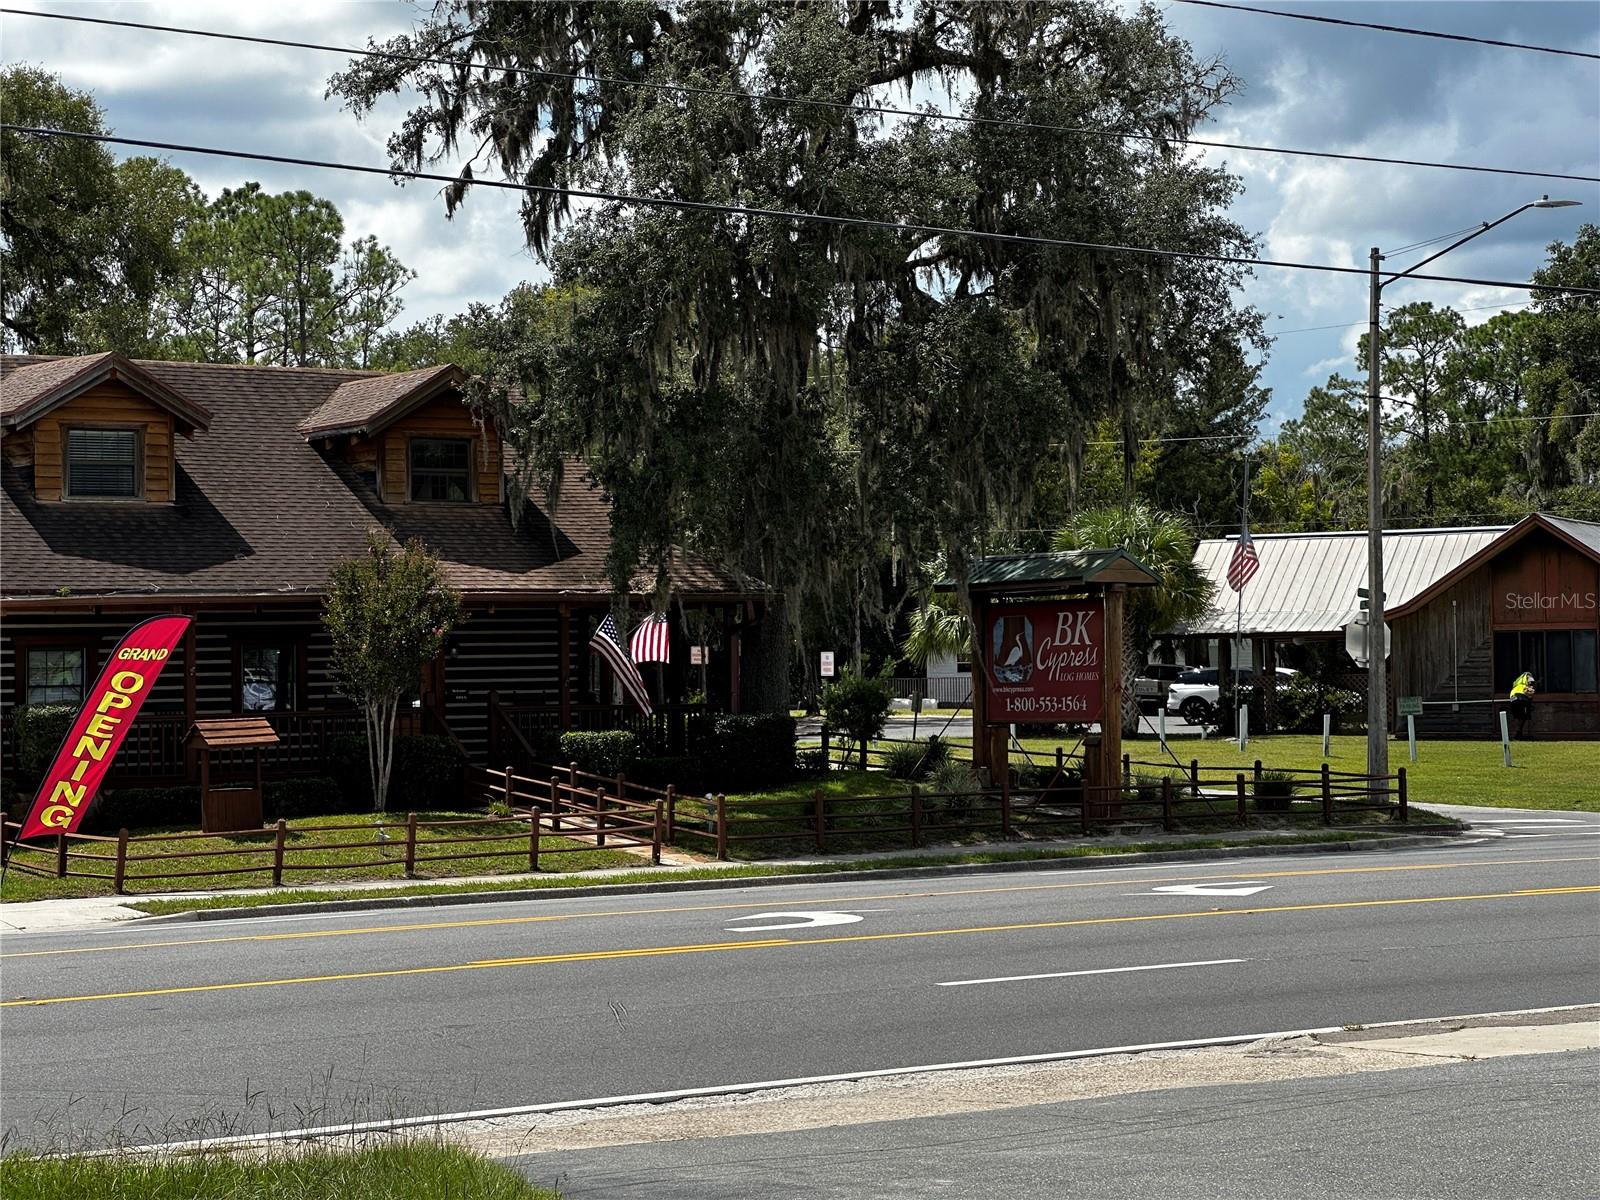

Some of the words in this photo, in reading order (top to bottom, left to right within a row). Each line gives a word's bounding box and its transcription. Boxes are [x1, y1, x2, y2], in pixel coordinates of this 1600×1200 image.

[1052, 610, 1096, 647] BK
[117, 647, 169, 662] GRAND
[1036, 637, 1099, 681] Cypress
[1059, 671, 1075, 681] LOG
[1075, 671, 1100, 681] HOMES
[1006, 696, 1088, 713] 1-800-553-1564
[40, 671, 145, 829] OPENING
